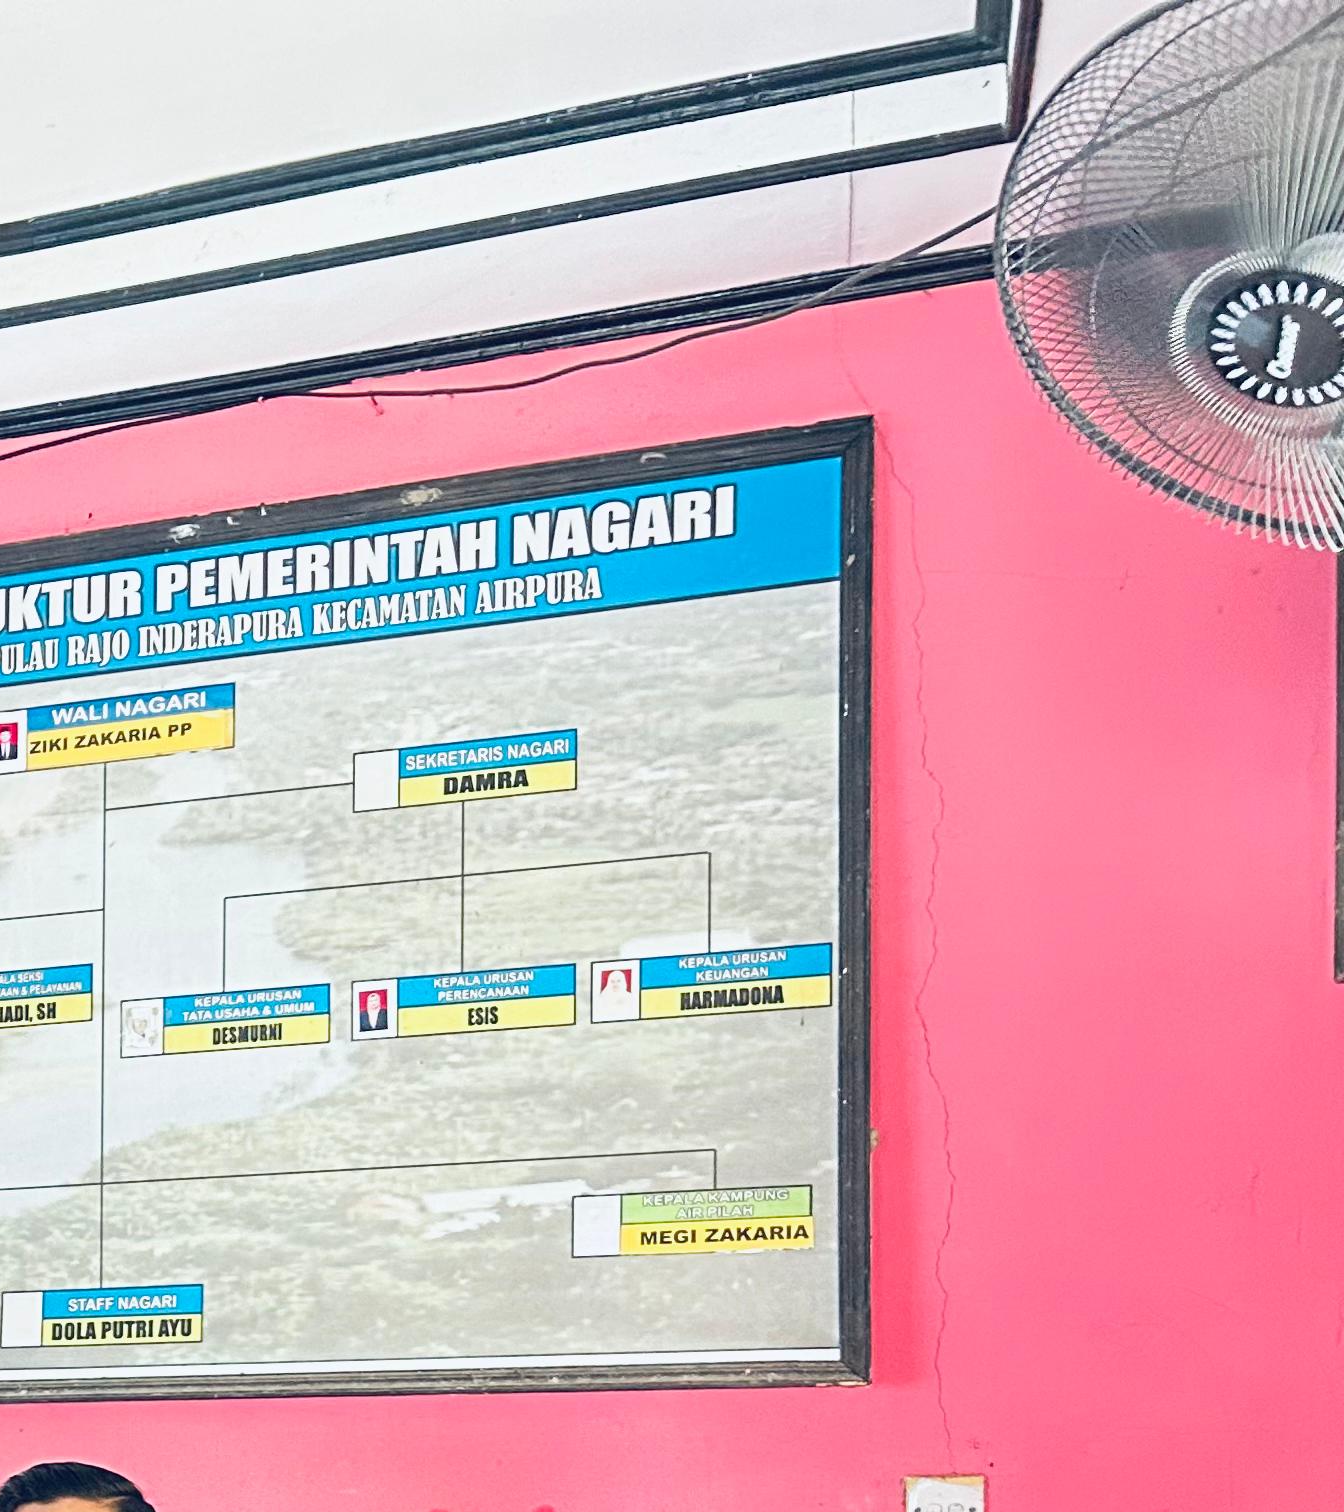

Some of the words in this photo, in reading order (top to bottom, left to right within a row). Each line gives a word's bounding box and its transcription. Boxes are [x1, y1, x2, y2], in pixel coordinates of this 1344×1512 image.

[156, 519, 497, 612] PEMERINTAH
[513, 485, 735, 564] NAGARI
[67, 630, 130, 666] RAJO
[138, 607, 303, 658] INDERAPURA
[312, 584, 466, 635] KECAMATAN
[475, 567, 603, 614] AIRPURA
[52, 703, 109, 725] WALI
[115, 691, 206, 718] NAGARI
[29, 737, 68, 754] ZIKI
[74, 726, 161, 749] ZAKARIA
[168, 723, 192, 737] PP
[406, 746, 503, 770] SEKRETARIS
[508, 739, 569, 759] NAGARI
[444, 769, 529, 795] DAMRA
[679, 956, 729, 969] KEPALA
[732, 951, 786, 965] URUSAN
[18, 972, 44, 982] SEKSI
[434, 976, 480, 988] KEPALA
[483, 971, 534, 984] URUSAN
[696, 967, 769, 982] KEUANGAN
[30, 982, 82, 995] PELAYANAN
[194, 995, 245, 1007] KEPALA
[248, 990, 301, 1003] URUSAN
[438, 986, 529, 1001] PERENCANAAN
[680, 985, 784, 1011] HARMADONA
[37, 1002, 56, 1020] SH
[183, 1010, 211, 1022] TATA
[215, 1006, 260, 1019] USAHA
[262, 1005, 271, 1015] &
[275, 1002, 314, 1014] UMUM
[468, 1006, 498, 1026] ESIS
[213, 1023, 282, 1045] DESMURNI
[642, 1193, 705, 1206] KEPALA
[708, 1189, 789, 1203] KAMPUNG
[675, 1207, 704, 1220] AIR
[708, 1205, 754, 1218] PILAH
[640, 1229, 696, 1245] MEGI
[704, 1224, 809, 1243] ZAKARIA
[68, 1297, 114, 1312] STAFF
[118, 1295, 177, 1310] NAGARI
[52, 1322, 96, 1340] DOLA
[101, 1320, 154, 1339] PUTRI
[158, 1318, 192, 1337] AYU
